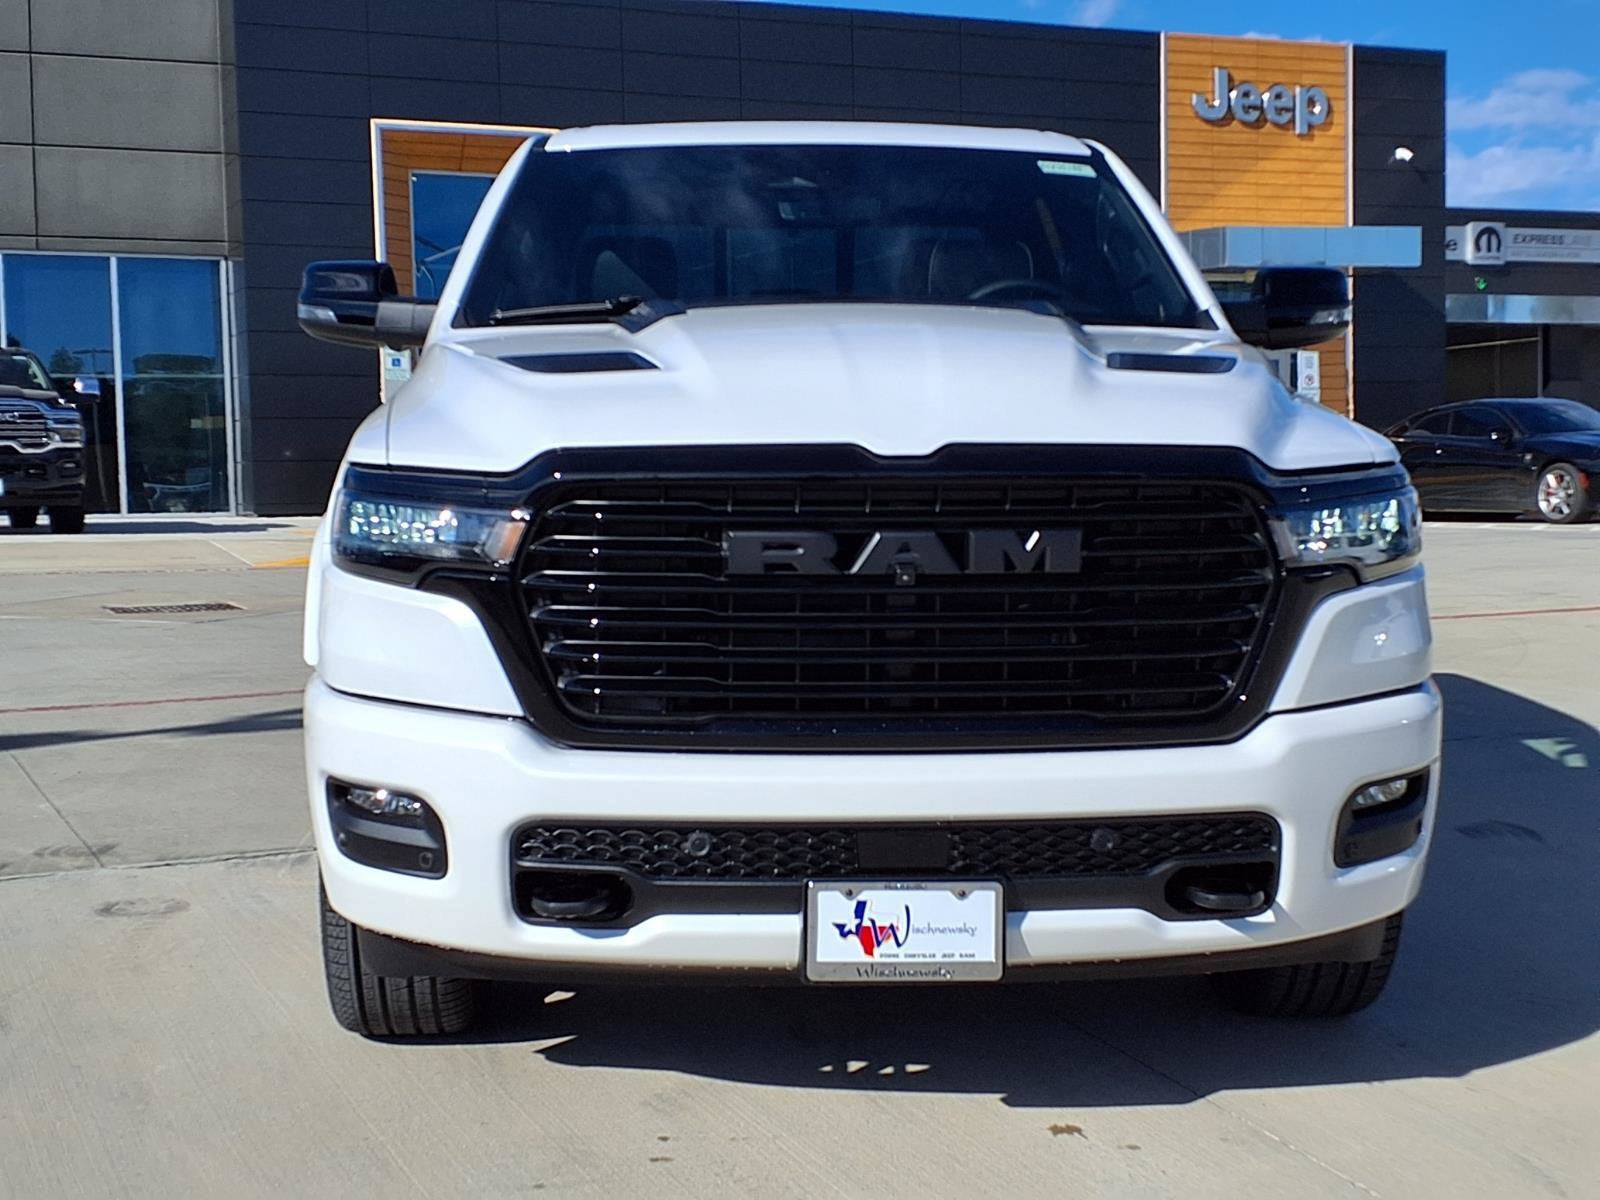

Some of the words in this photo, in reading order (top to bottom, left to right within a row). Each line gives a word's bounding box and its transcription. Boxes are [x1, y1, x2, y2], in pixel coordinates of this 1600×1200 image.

[1192, 67, 1330, 135] Jeep
[1513, 233, 1565, 245] EXPRESS
[723, 530, 1083, 575] RAM
